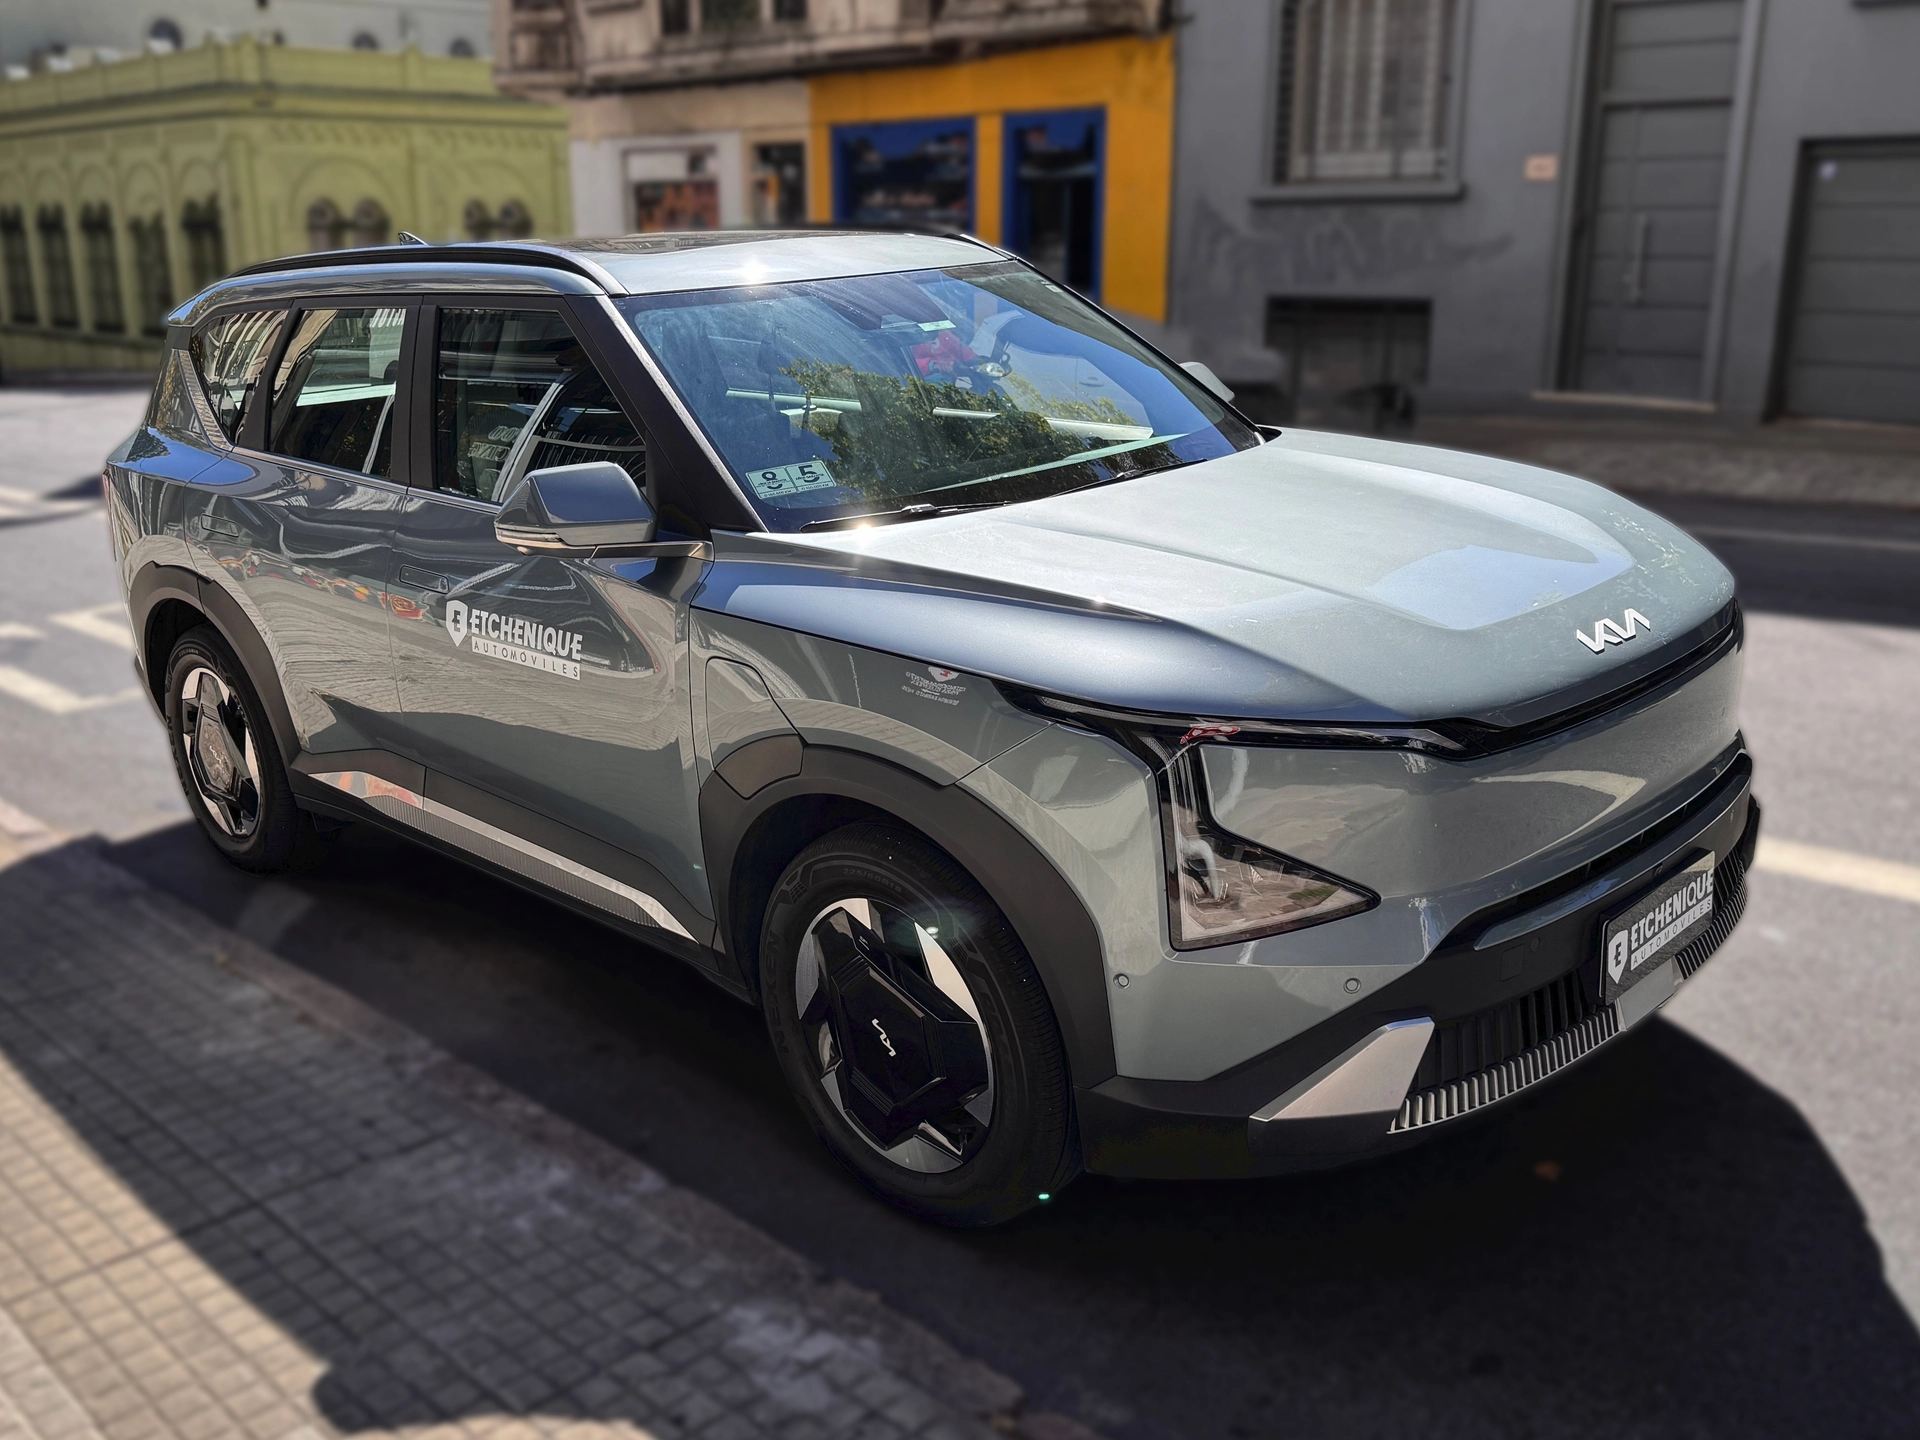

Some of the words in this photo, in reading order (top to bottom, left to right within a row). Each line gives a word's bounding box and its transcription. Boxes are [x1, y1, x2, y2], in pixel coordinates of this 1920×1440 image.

[798, 464, 820, 483] 5
[469, 608, 583, 661] ETCHENIQUE
[1576, 608, 1651, 654] KIA
[473, 640, 579, 678] AUTOMÓVILES
[1630, 870, 1713, 950] ETCHENIQUE
